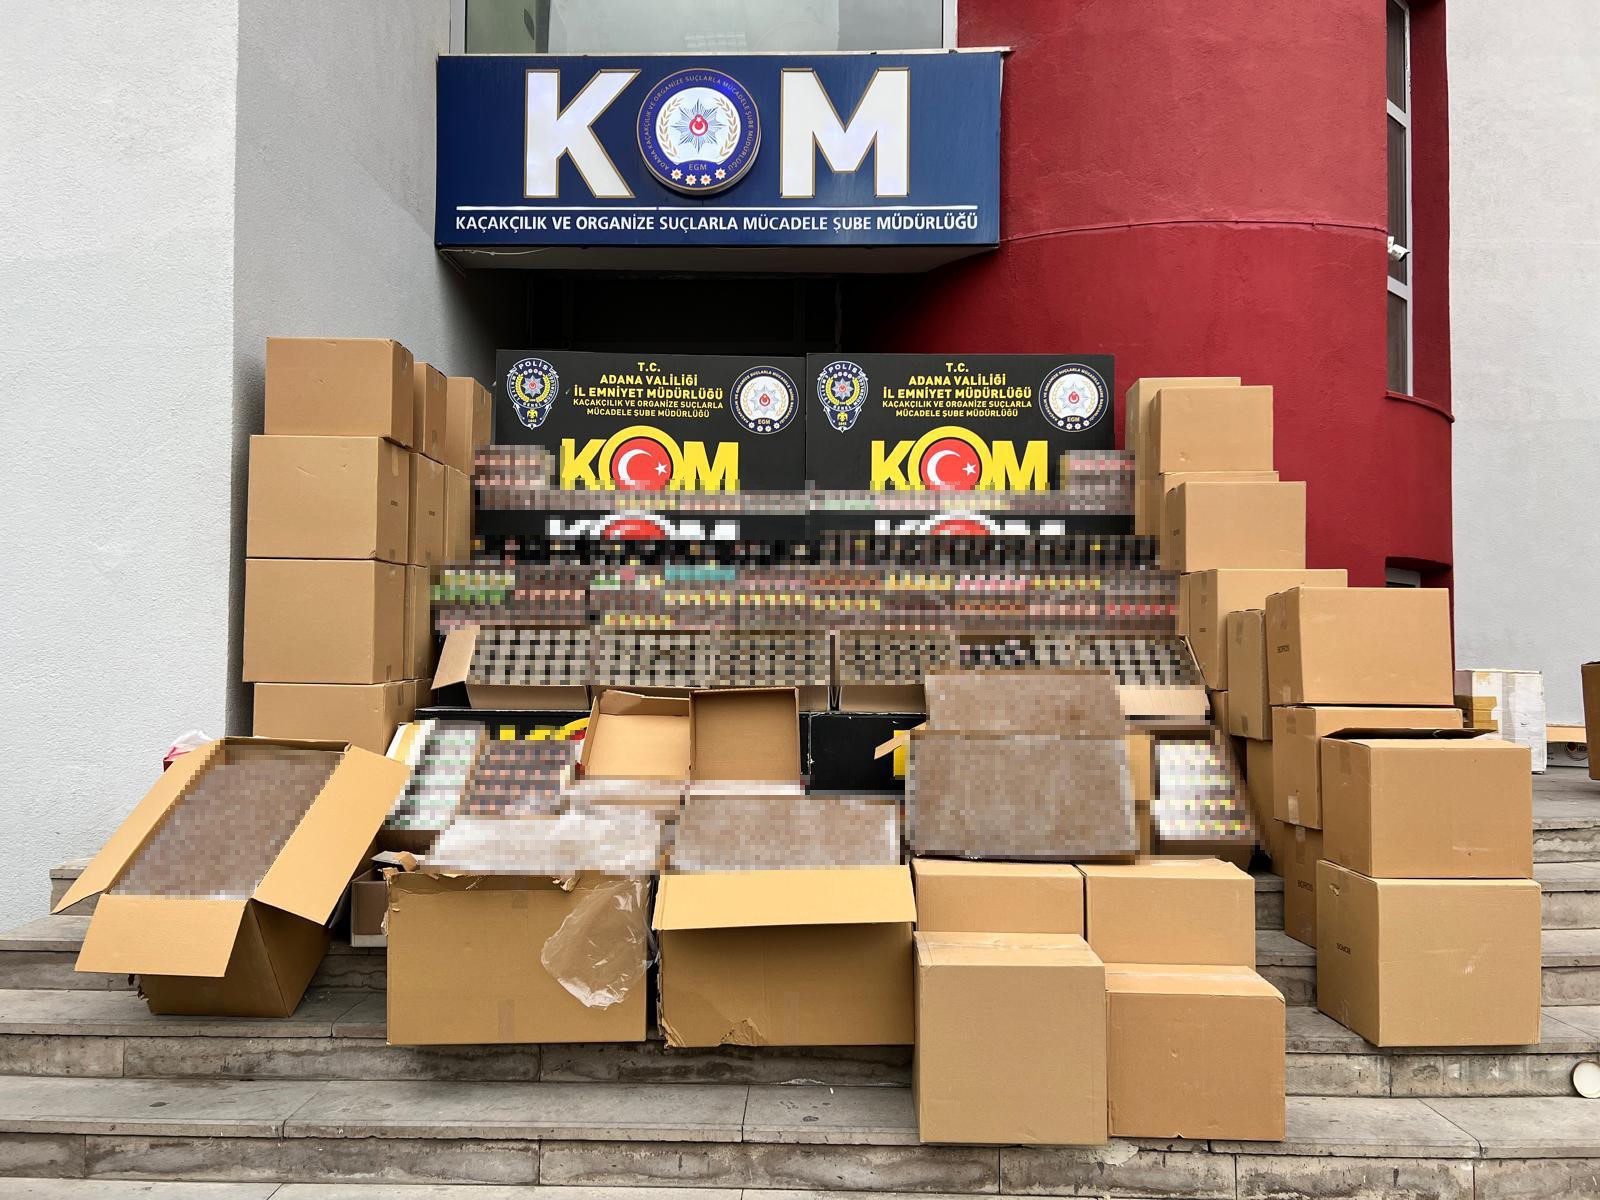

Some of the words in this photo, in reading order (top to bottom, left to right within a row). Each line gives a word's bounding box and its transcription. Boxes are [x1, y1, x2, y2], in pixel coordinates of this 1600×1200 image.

[688, 163, 707, 171] EGM
[456, 216, 547, 234] KAÇAKÇILIK
[552, 216, 571, 230] VE
[575, 213, 655, 230] ORGANİZE
[659, 216, 738, 234] SUÇLARLA
[743, 214, 828, 230] MÜCADELE
[833, 216, 872, 234] ŞUBE
[876, 212, 978, 230] MÜDÜRLÜĞÜ
[518, 360, 548, 370] POLİS
[638, 362, 661, 372] T.C.
[828, 363, 858, 374] POLİS
[946, 362, 969, 372] T.C.
[600, 374, 643, 384] ADANA
[646, 374, 698, 386] VALİLİĞİ
[908, 376, 951, 386] ADANA
[954, 374, 1006, 386] VALİLİĞİ
[574, 385, 586, 396] İL
[589, 385, 644, 398] EMNİYET
[646, 387, 723, 400] MÜDÜRLÜĞÜ
[883, 386, 894, 398] İL
[898, 386, 952, 398] EMNİYET
[955, 387, 1032, 398] MÜDÜRLÜĞÜ
[573, 399, 623, 408] KAÇAKÇILIK
[637, 400, 678, 408] ORGANİZE
[680, 402, 724, 410] SUÇLARLA
[882, 400, 932, 408] KAÇAKÇILIK
[946, 400, 986, 408] ORGANİZE
[586, 408, 632, 416] MÜCADELE
[634, 410, 655, 418] ŞUBE
[658, 409, 710, 418] MÜDÜRLÜĞÜ
[942, 410, 964, 418] ŞUBE
[967, 409, 1018, 417] MÜDÜRLÜĞÜ
